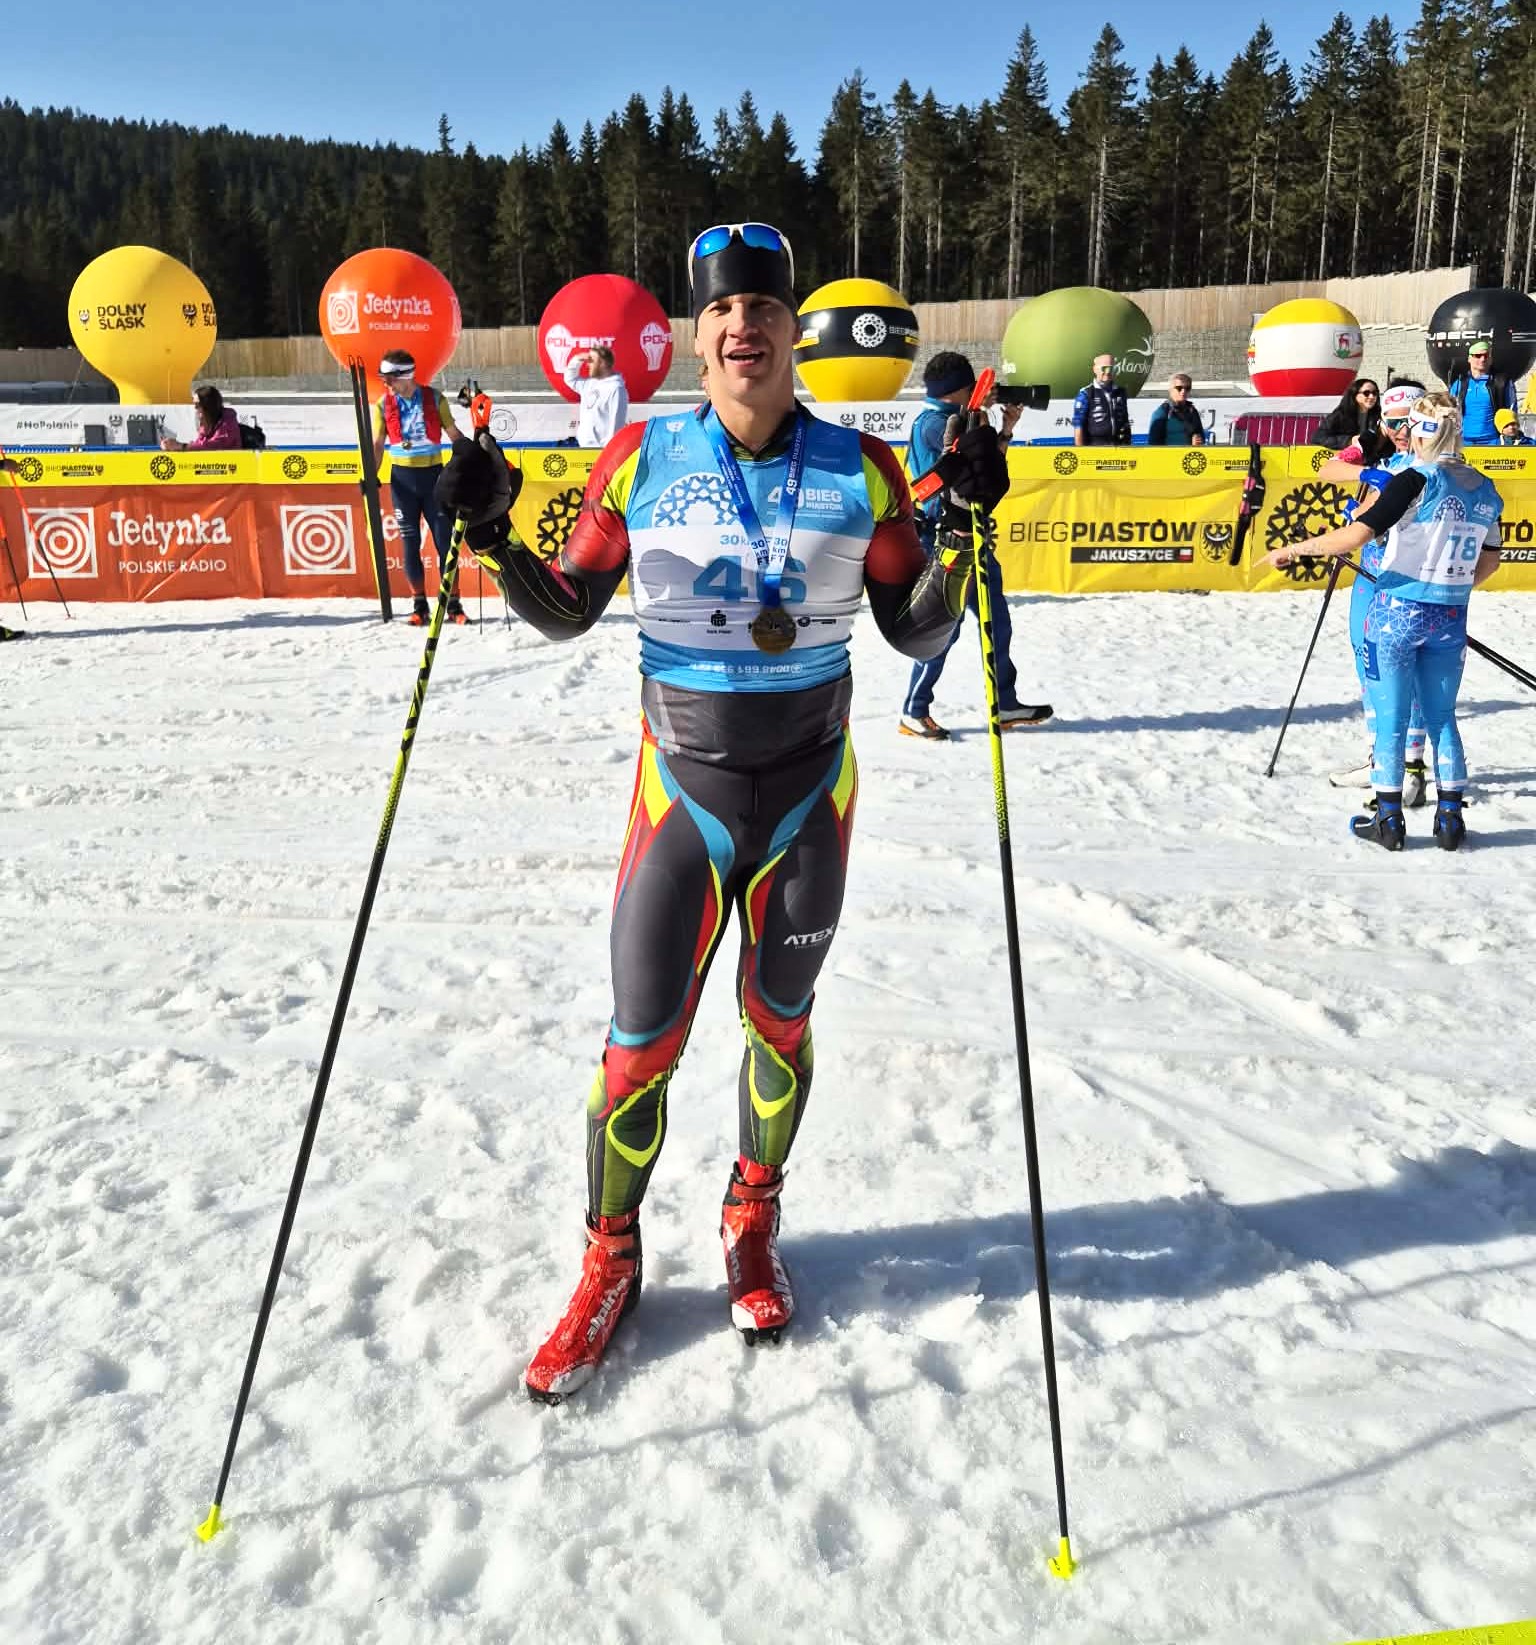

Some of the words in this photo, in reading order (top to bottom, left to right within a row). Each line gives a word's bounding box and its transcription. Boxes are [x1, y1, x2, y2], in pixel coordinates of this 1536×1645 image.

[97, 303, 147, 317] DOLNY
[363, 293, 433, 319] Jedynka
[98, 315, 146, 331] ŚLĄSK
[547, 336, 616, 348] POLTENT
[863, 412, 906, 422] DOLNY
[786, 479, 797, 495] 49
[805, 488, 842, 502] BIEG
[108, 512, 231, 555] Jedynka
[720, 535, 739, 545] 30
[751, 539, 765, 550] 30
[774, 537, 788, 546] 30
[1447, 535, 1477, 561] 78
[773, 546, 786, 554] km
[1090, 549, 1174, 561] JAKUSZYCE
[1499, 550, 1536, 561] ZYCE
[770, 554, 785, 563] FT
[118, 559, 176, 574] POLSKIE
[180, 558, 227, 573] RADIO
[693, 555, 807, 604] 46
[783, 924, 835, 946] ATEX
